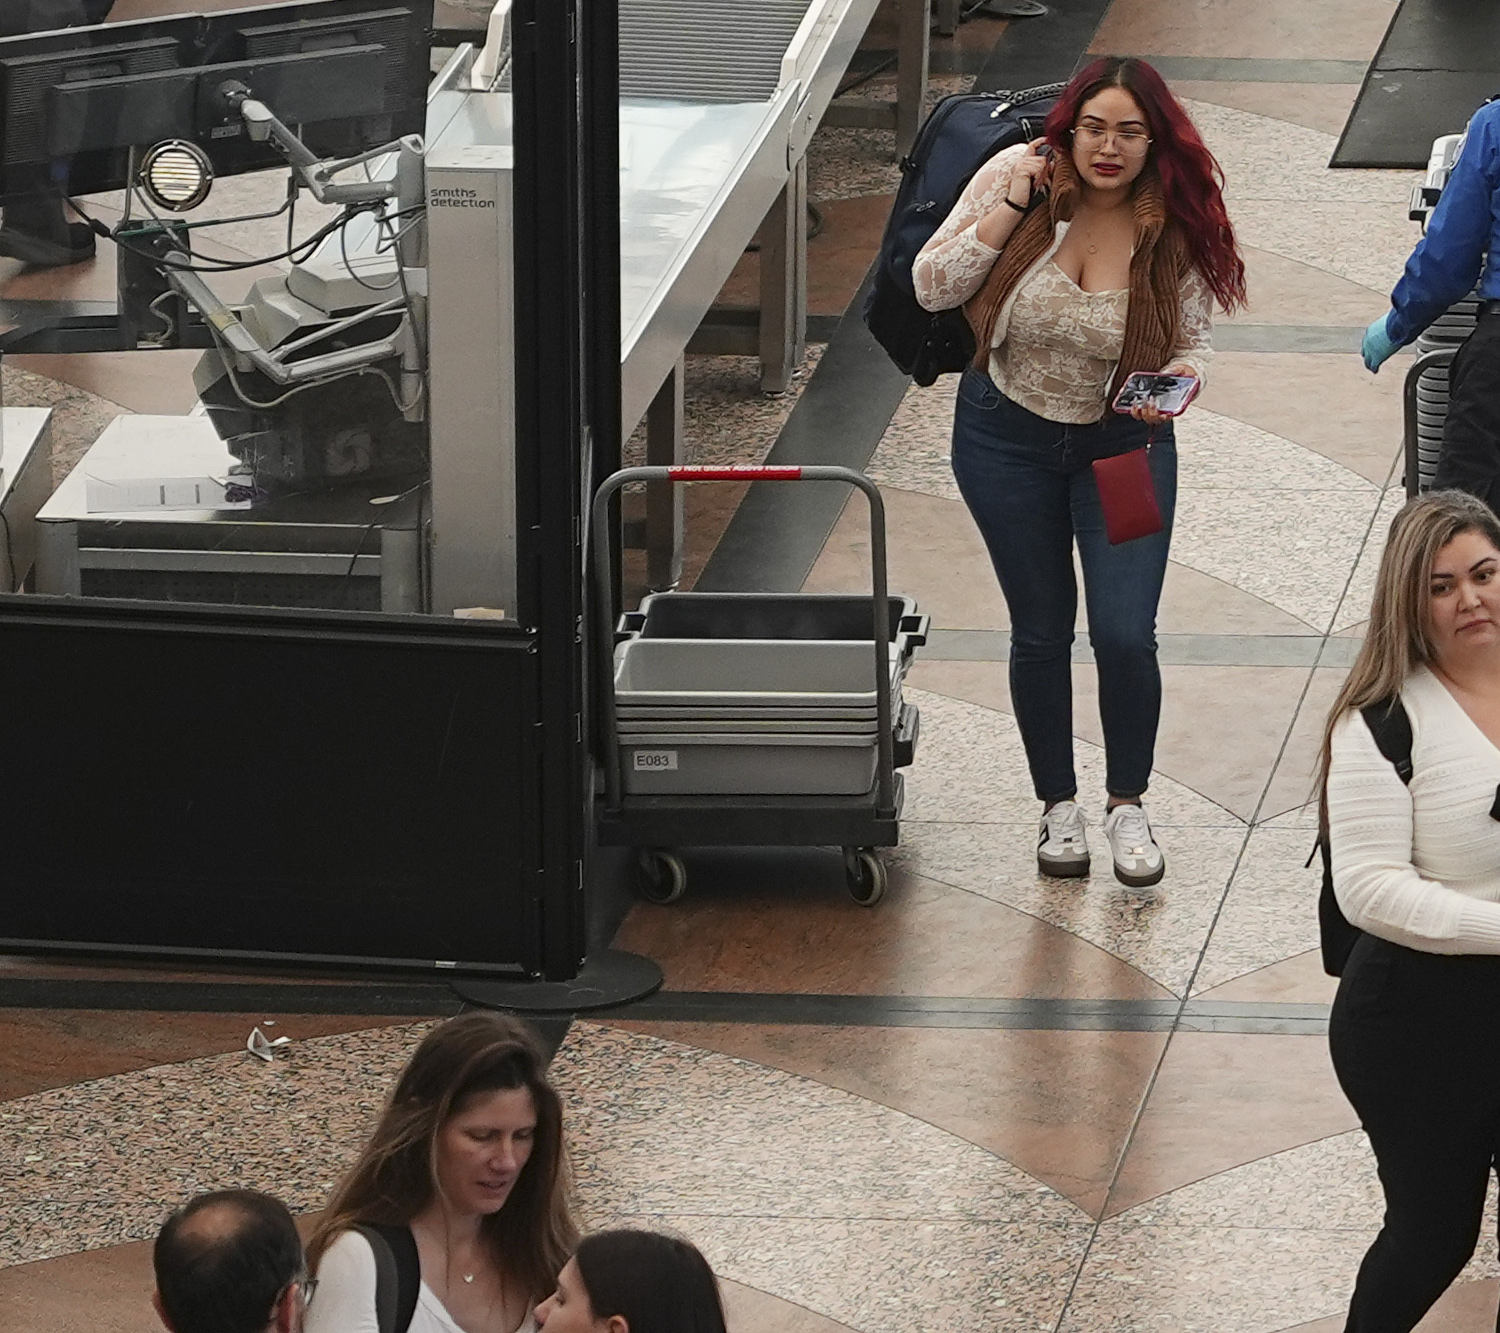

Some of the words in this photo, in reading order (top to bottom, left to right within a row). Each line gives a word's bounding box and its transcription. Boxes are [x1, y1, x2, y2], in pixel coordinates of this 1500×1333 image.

[431, 188, 477, 199] smiths
[431, 198, 496, 210] detection
[637, 754, 669, 766] E083
